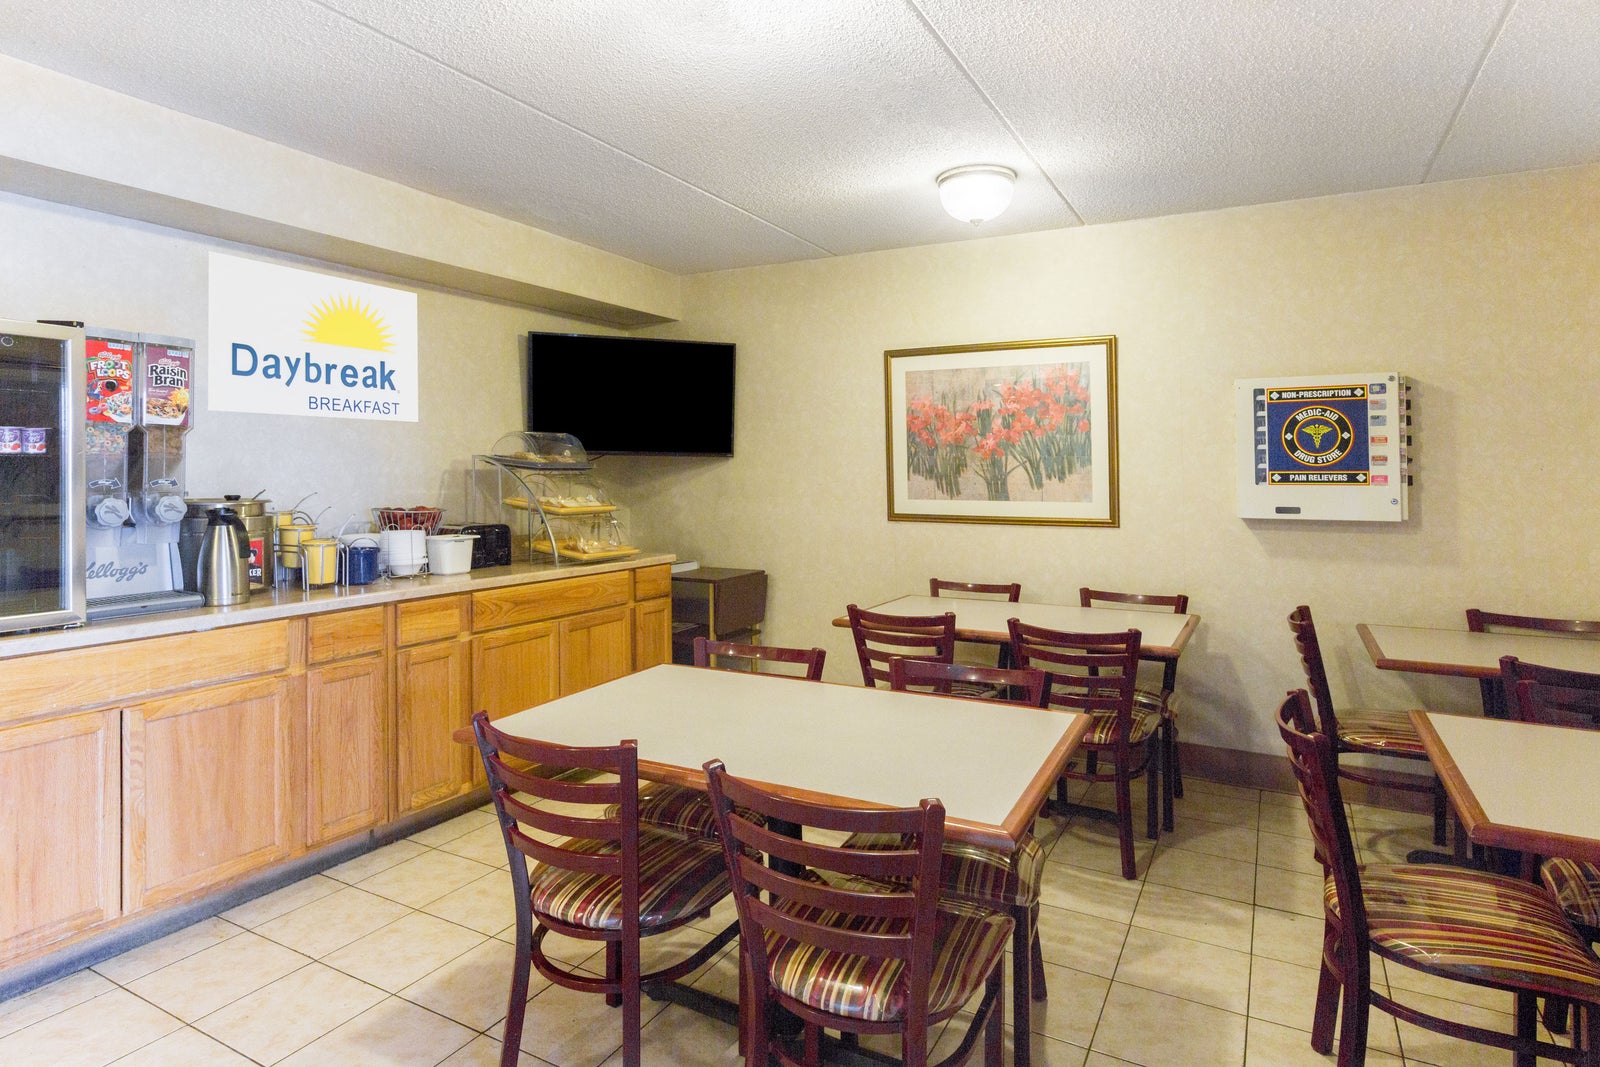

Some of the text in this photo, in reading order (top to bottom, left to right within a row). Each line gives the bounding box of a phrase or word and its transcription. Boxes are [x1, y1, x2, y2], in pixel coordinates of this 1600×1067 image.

[90, 360, 129, 371] FROOT
[149, 364, 188, 379] Raisin
[232, 342, 396, 391] Daybreak
[96, 368, 131, 379] LOOPS
[154, 375, 184, 387] Bran
[1281, 389, 1352, 399] NON-PRESCRIPTION
[308, 396, 400, 415] BREAKFAST
[1295, 408, 1339, 422] MEDIC-AID
[1293, 448, 1343, 464] DRUG STORE
[1289, 473, 1348, 482] PAIN RELIEVERS
